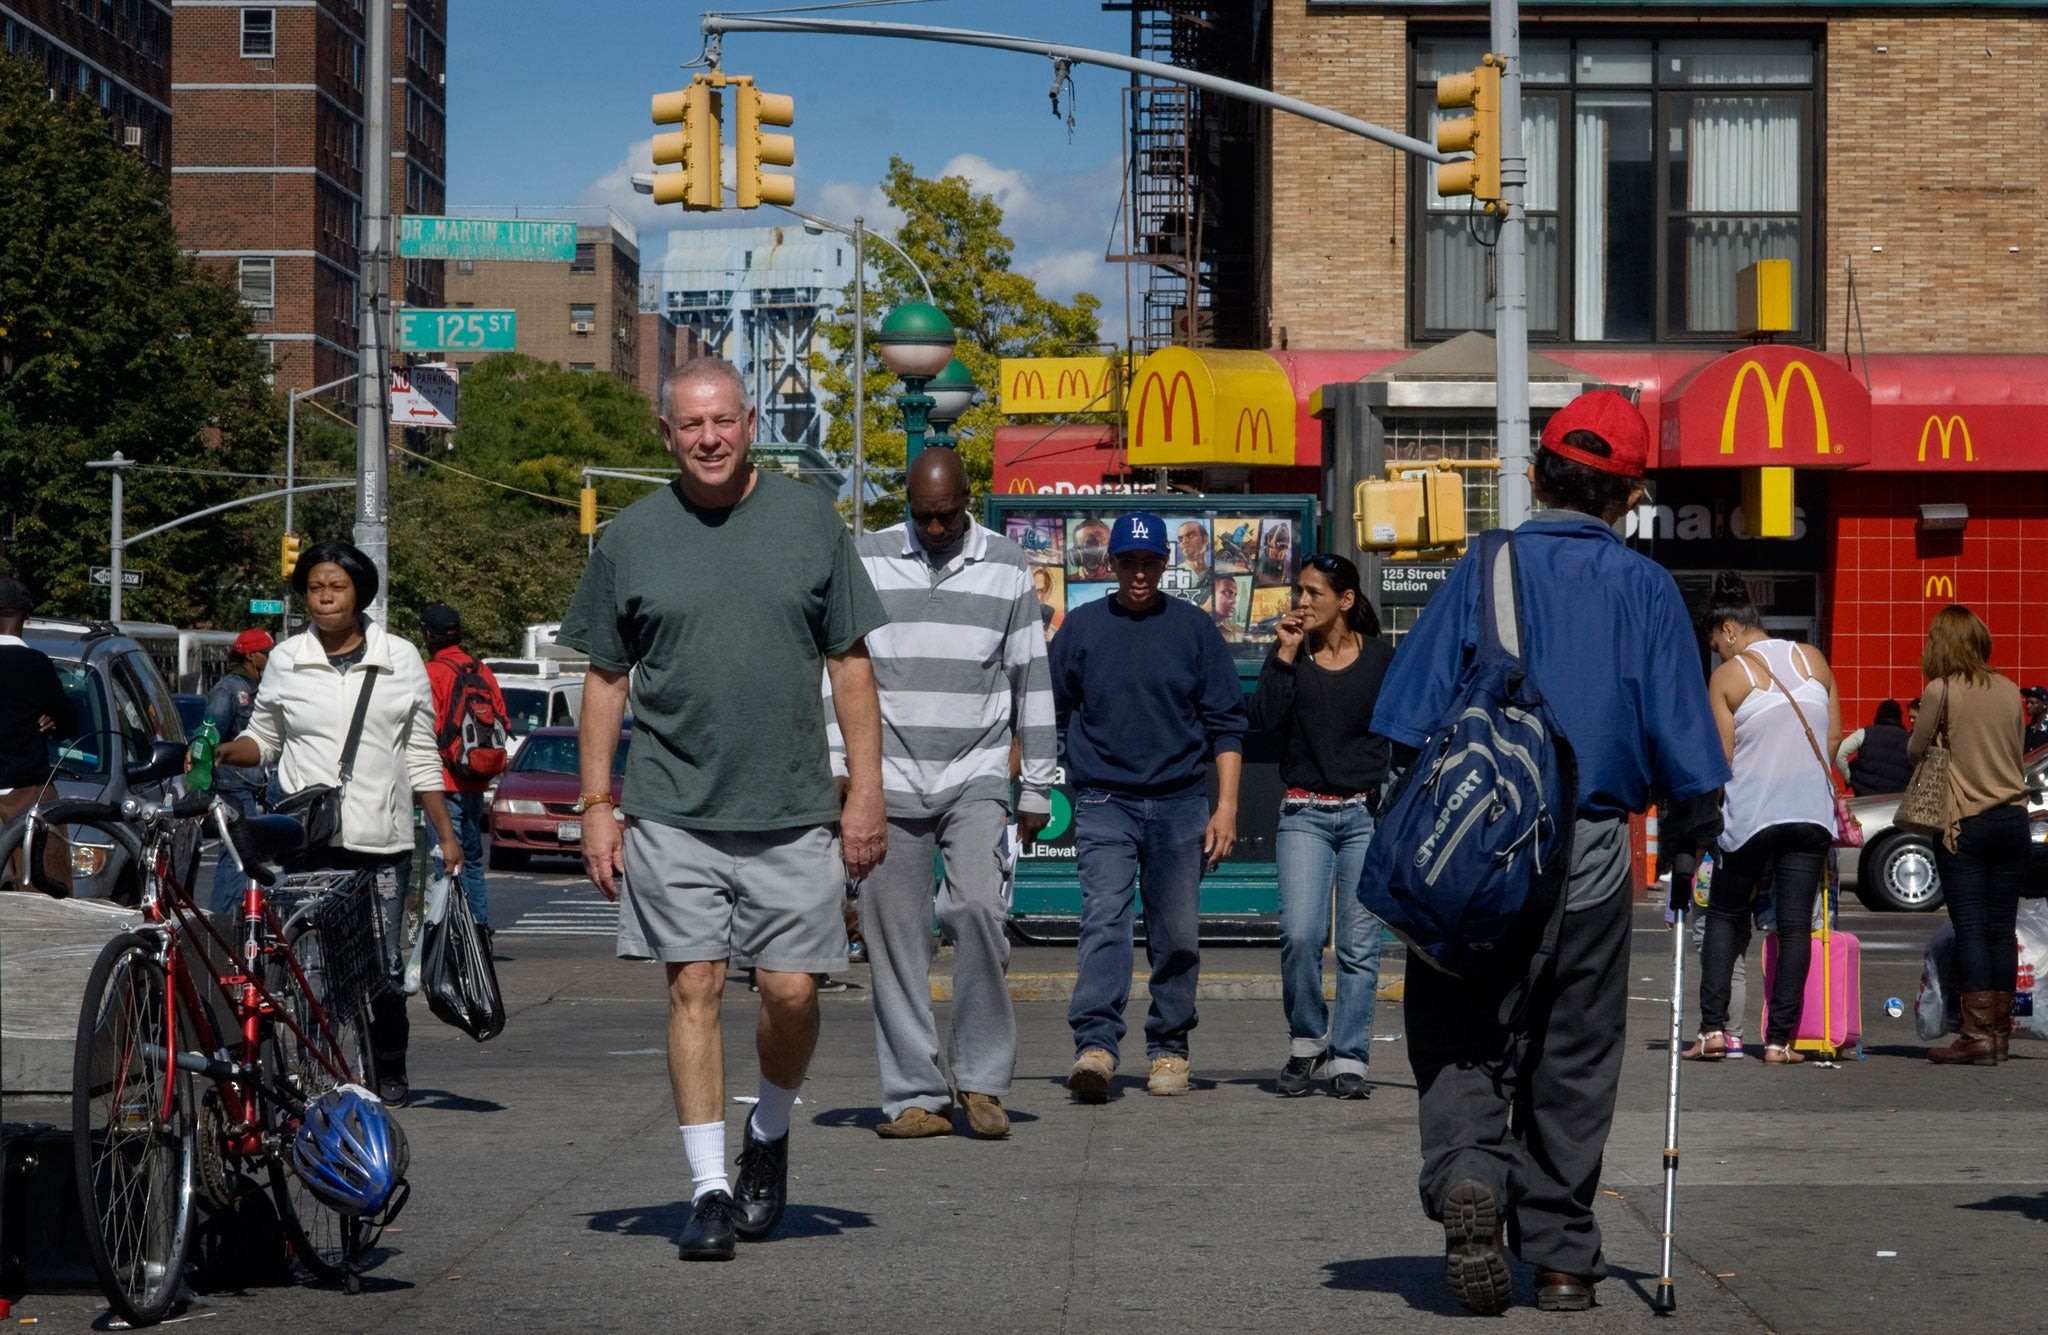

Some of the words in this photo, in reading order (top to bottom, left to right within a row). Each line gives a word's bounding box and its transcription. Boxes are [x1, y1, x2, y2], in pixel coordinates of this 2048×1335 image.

[402, 219, 423, 240] DR
[435, 220, 497, 242] MARTIN
[509, 222, 573, 246] LUTHER
[401, 315, 417, 346] E
[437, 314, 485, 347] 125
[489, 315, 512, 332] ST
[392, 371, 410, 390] NO
[416, 373, 452, 386] PARKING
[1131, 517, 1149, 539] LA
[1382, 568, 1404, 580] 125
[1407, 568, 1447, 580] Street
[1382, 580, 1428, 592] Station
[1036, 845, 1078, 858] Elevat
